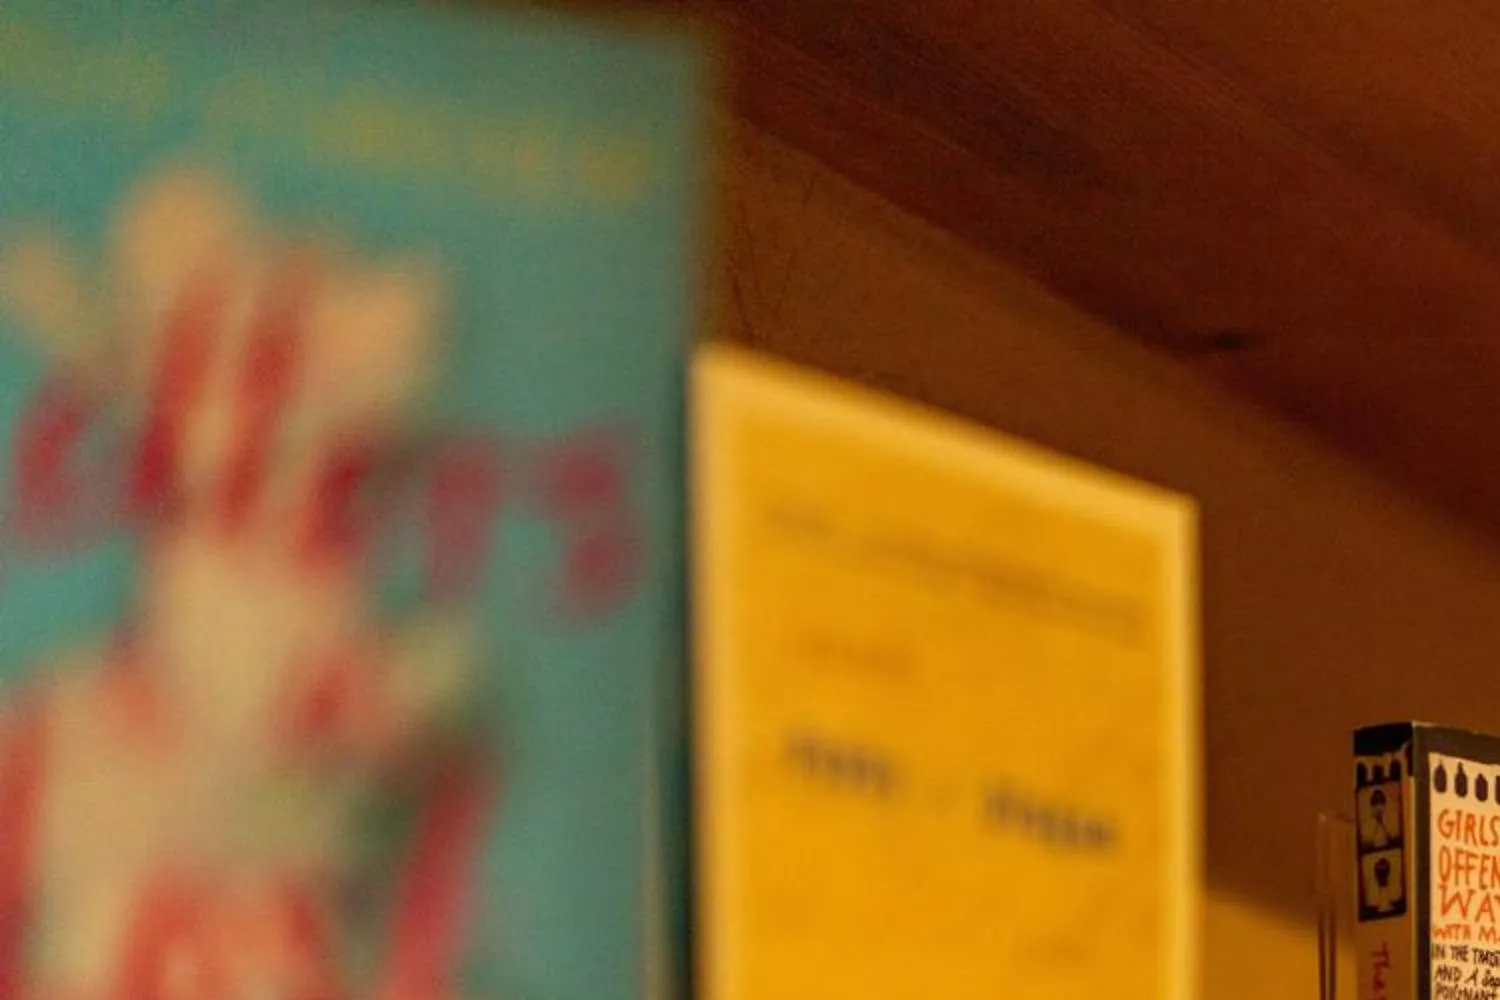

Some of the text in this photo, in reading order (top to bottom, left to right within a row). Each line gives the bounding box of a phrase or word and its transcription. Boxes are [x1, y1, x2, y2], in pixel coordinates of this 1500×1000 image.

[1438, 806, 1499, 848] GIRLS
[1371, 941, 1393, 988] The
[1450, 944, 1469, 963] THE
[1435, 964, 1462, 982] AND
